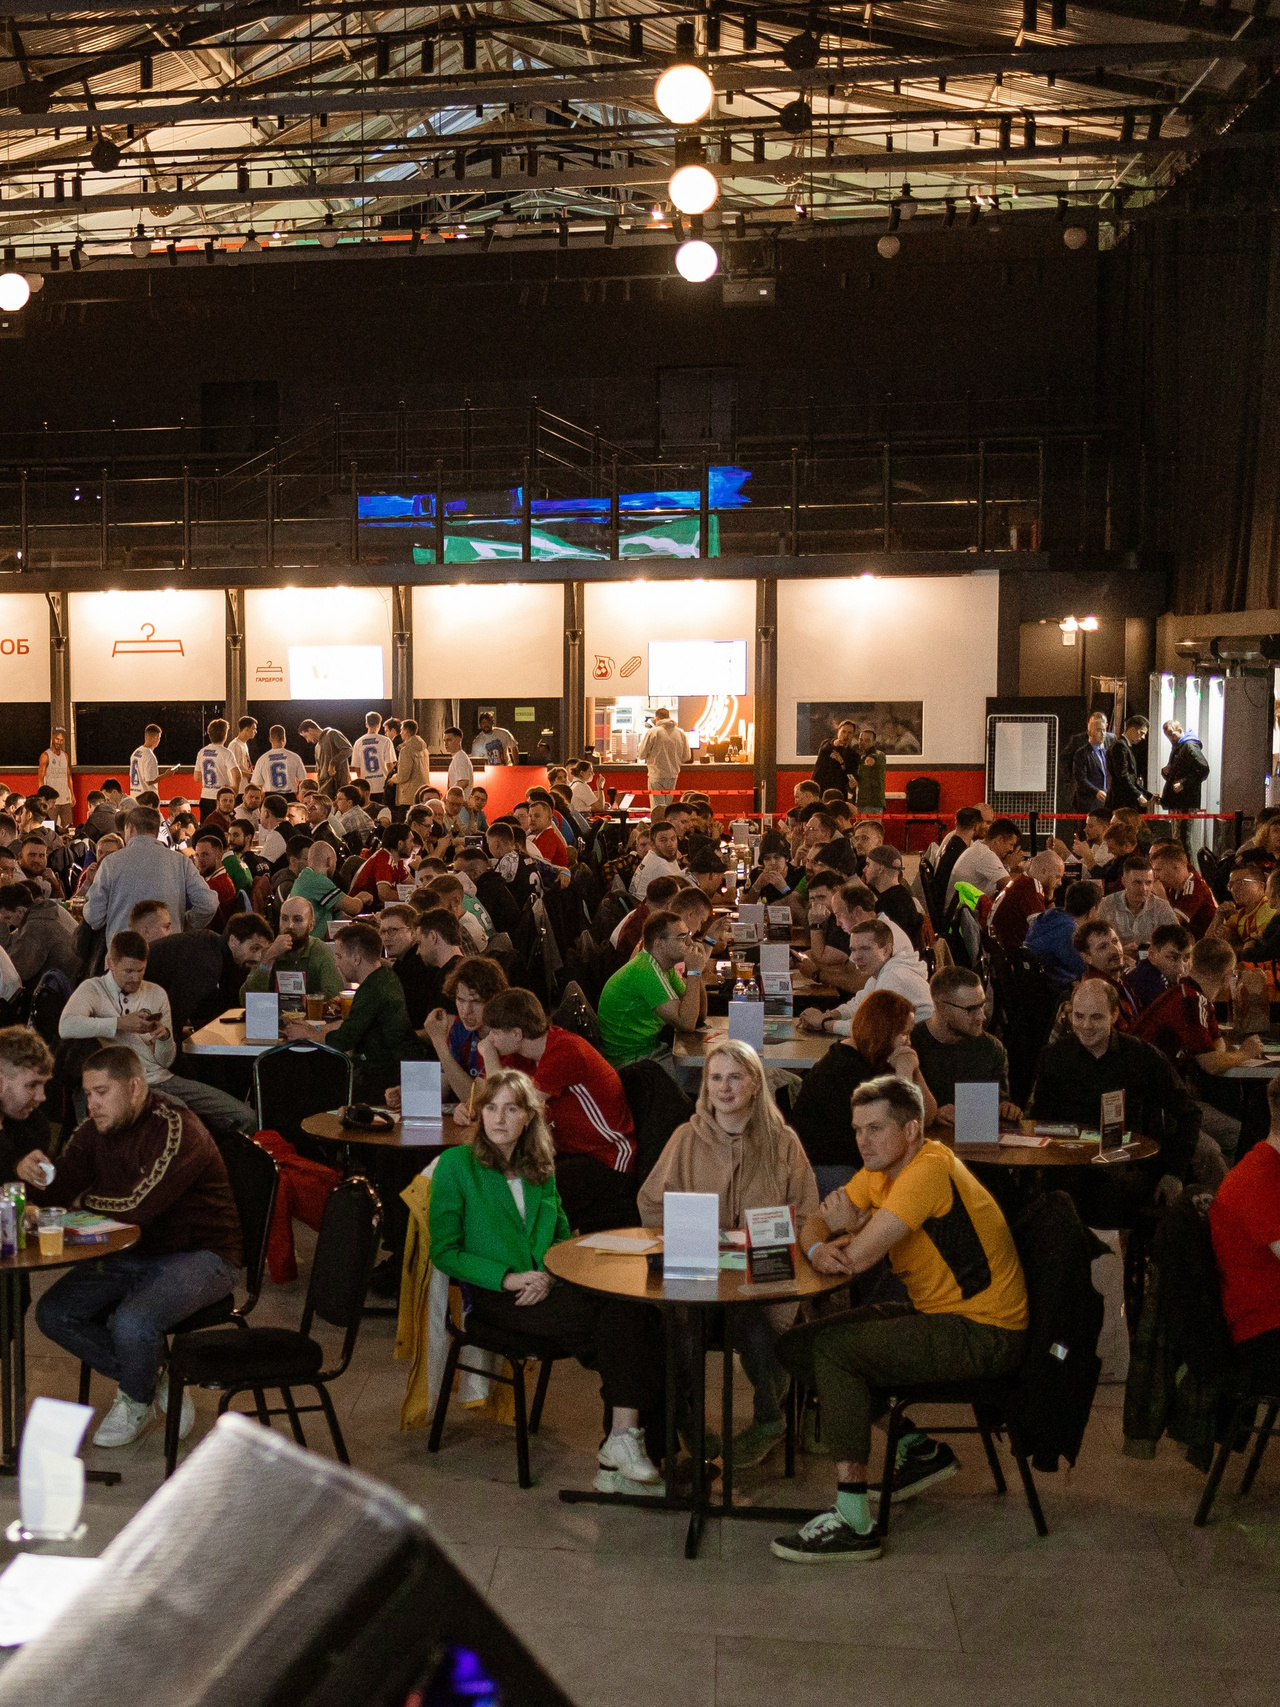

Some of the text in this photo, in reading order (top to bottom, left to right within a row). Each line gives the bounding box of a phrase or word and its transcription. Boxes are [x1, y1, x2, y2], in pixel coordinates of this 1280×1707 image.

[131, 758, 140, 786] 6
[202, 758, 217, 786] 6
[363, 746, 380, 773] 6
[270, 762, 287, 788] 6
